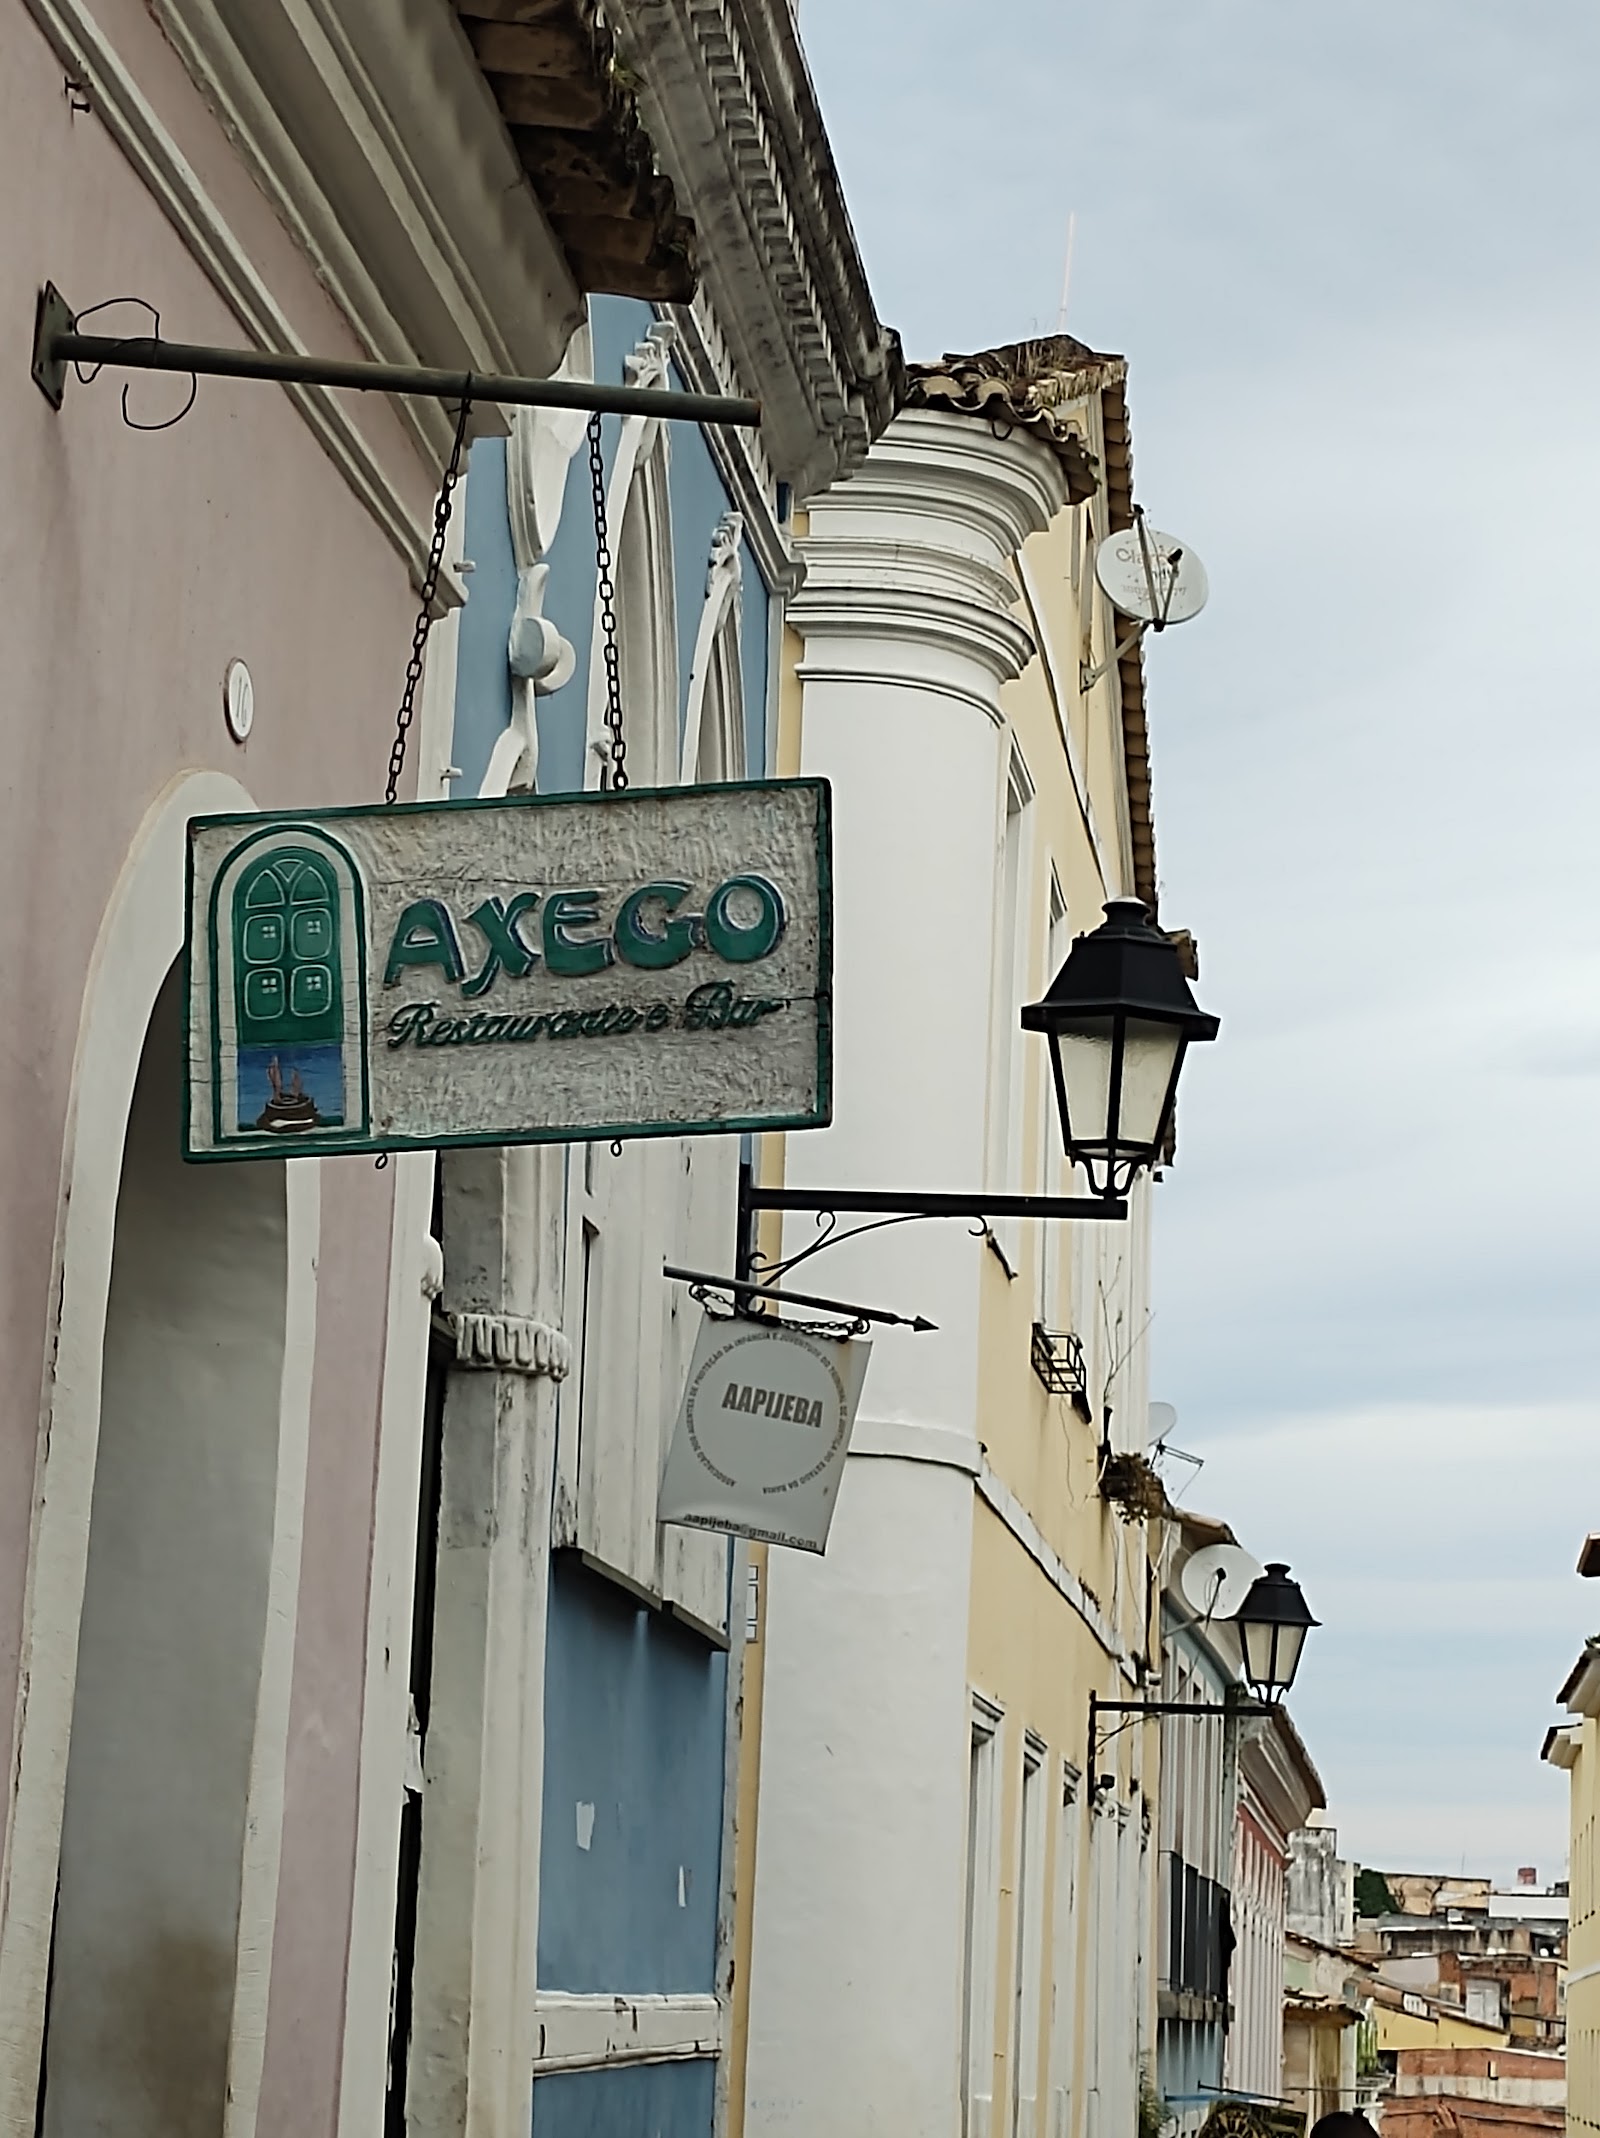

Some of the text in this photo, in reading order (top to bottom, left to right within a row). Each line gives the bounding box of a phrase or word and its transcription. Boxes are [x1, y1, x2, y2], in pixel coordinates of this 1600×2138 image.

[383, 872, 787, 997] AXEGO
[387, 979, 785, 1048] Restaurante e Bar
[722, 1382, 823, 1428] AAPIJEBA
